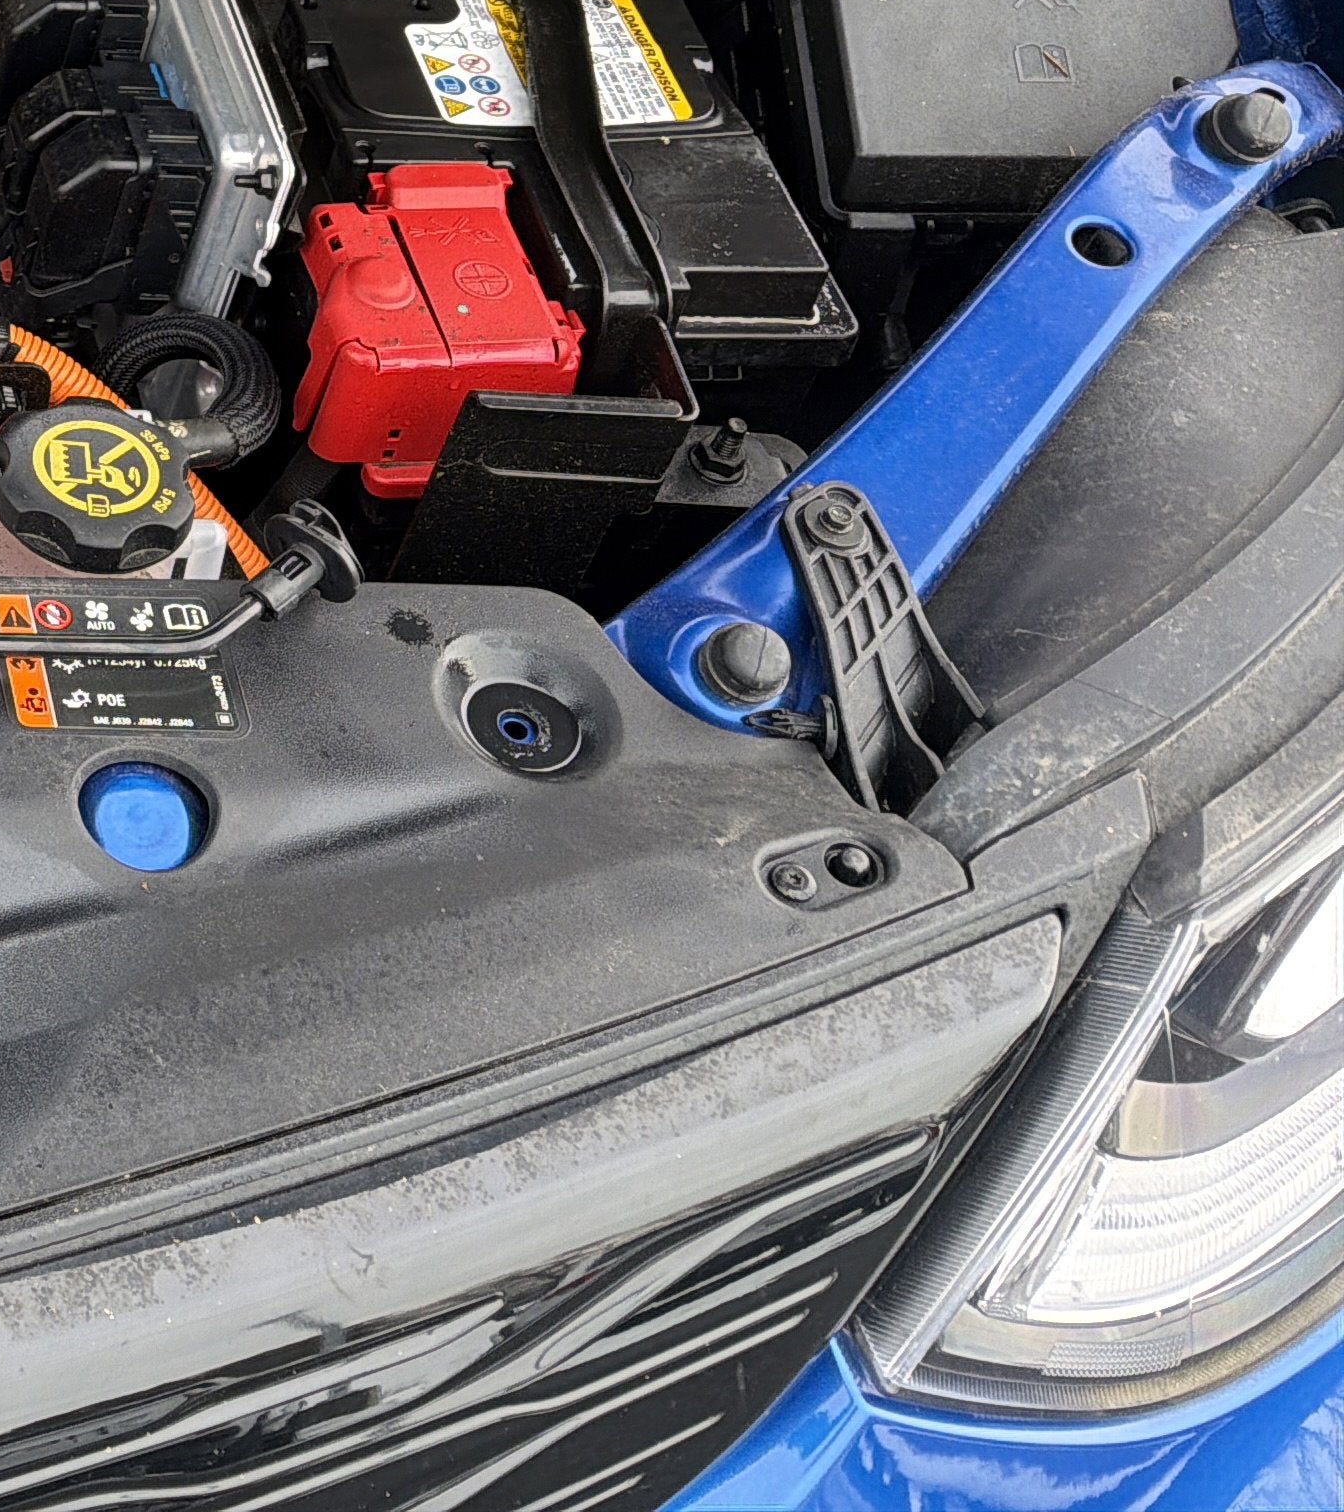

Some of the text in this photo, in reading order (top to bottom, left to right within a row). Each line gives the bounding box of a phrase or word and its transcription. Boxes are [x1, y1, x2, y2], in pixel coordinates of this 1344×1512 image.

[140, 429, 170, 461] 35 kPa
[152, 488, 176, 514] 5 PSI
[87, 621, 115, 631] AUTO
[97, 694, 126, 707] POE
[93, 717, 110, 725] SAE
